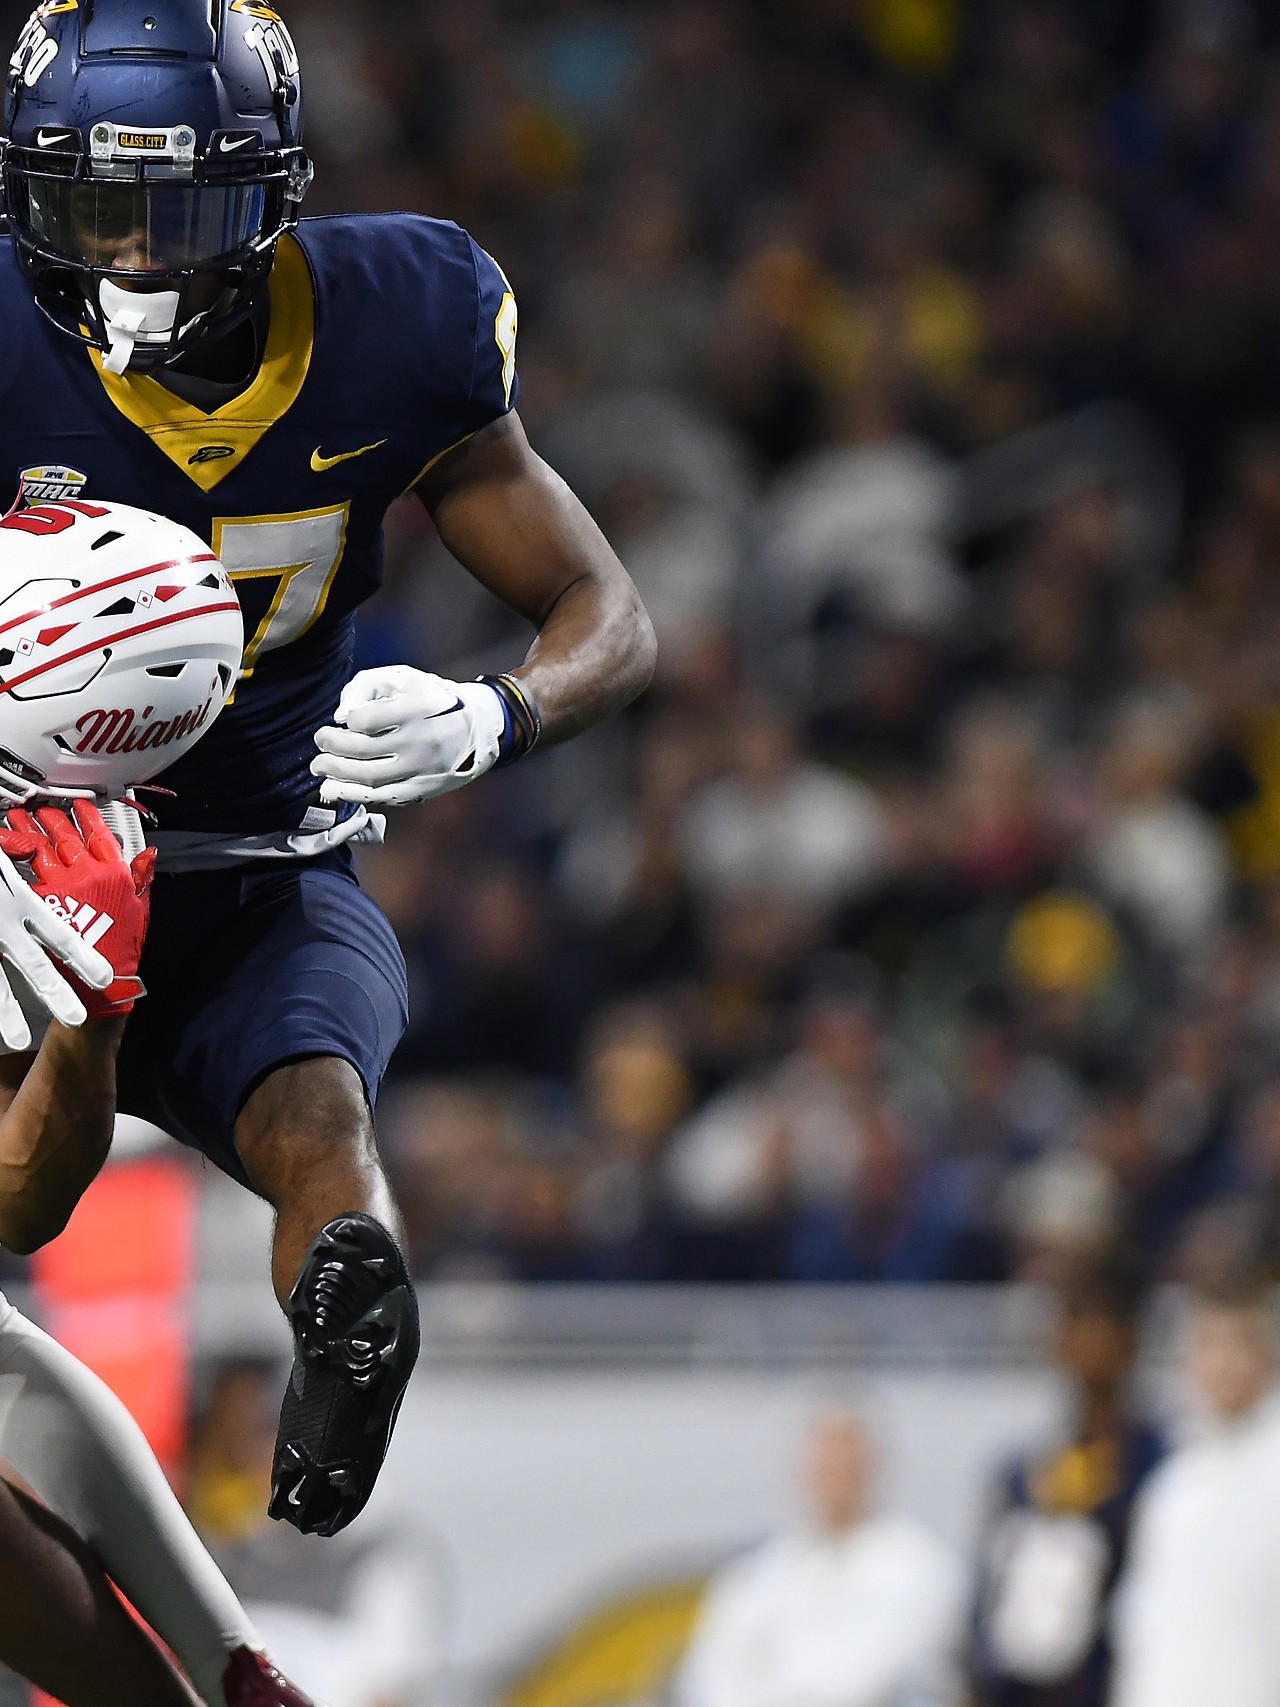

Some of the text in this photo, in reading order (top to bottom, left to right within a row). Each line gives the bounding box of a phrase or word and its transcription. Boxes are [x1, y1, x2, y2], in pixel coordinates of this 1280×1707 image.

[120, 133, 166, 149] GLASS CITY
[23, 482, 81, 500] MAC
[211, 500, 352, 679] 7
[75, 676, 218, 755] Miami
